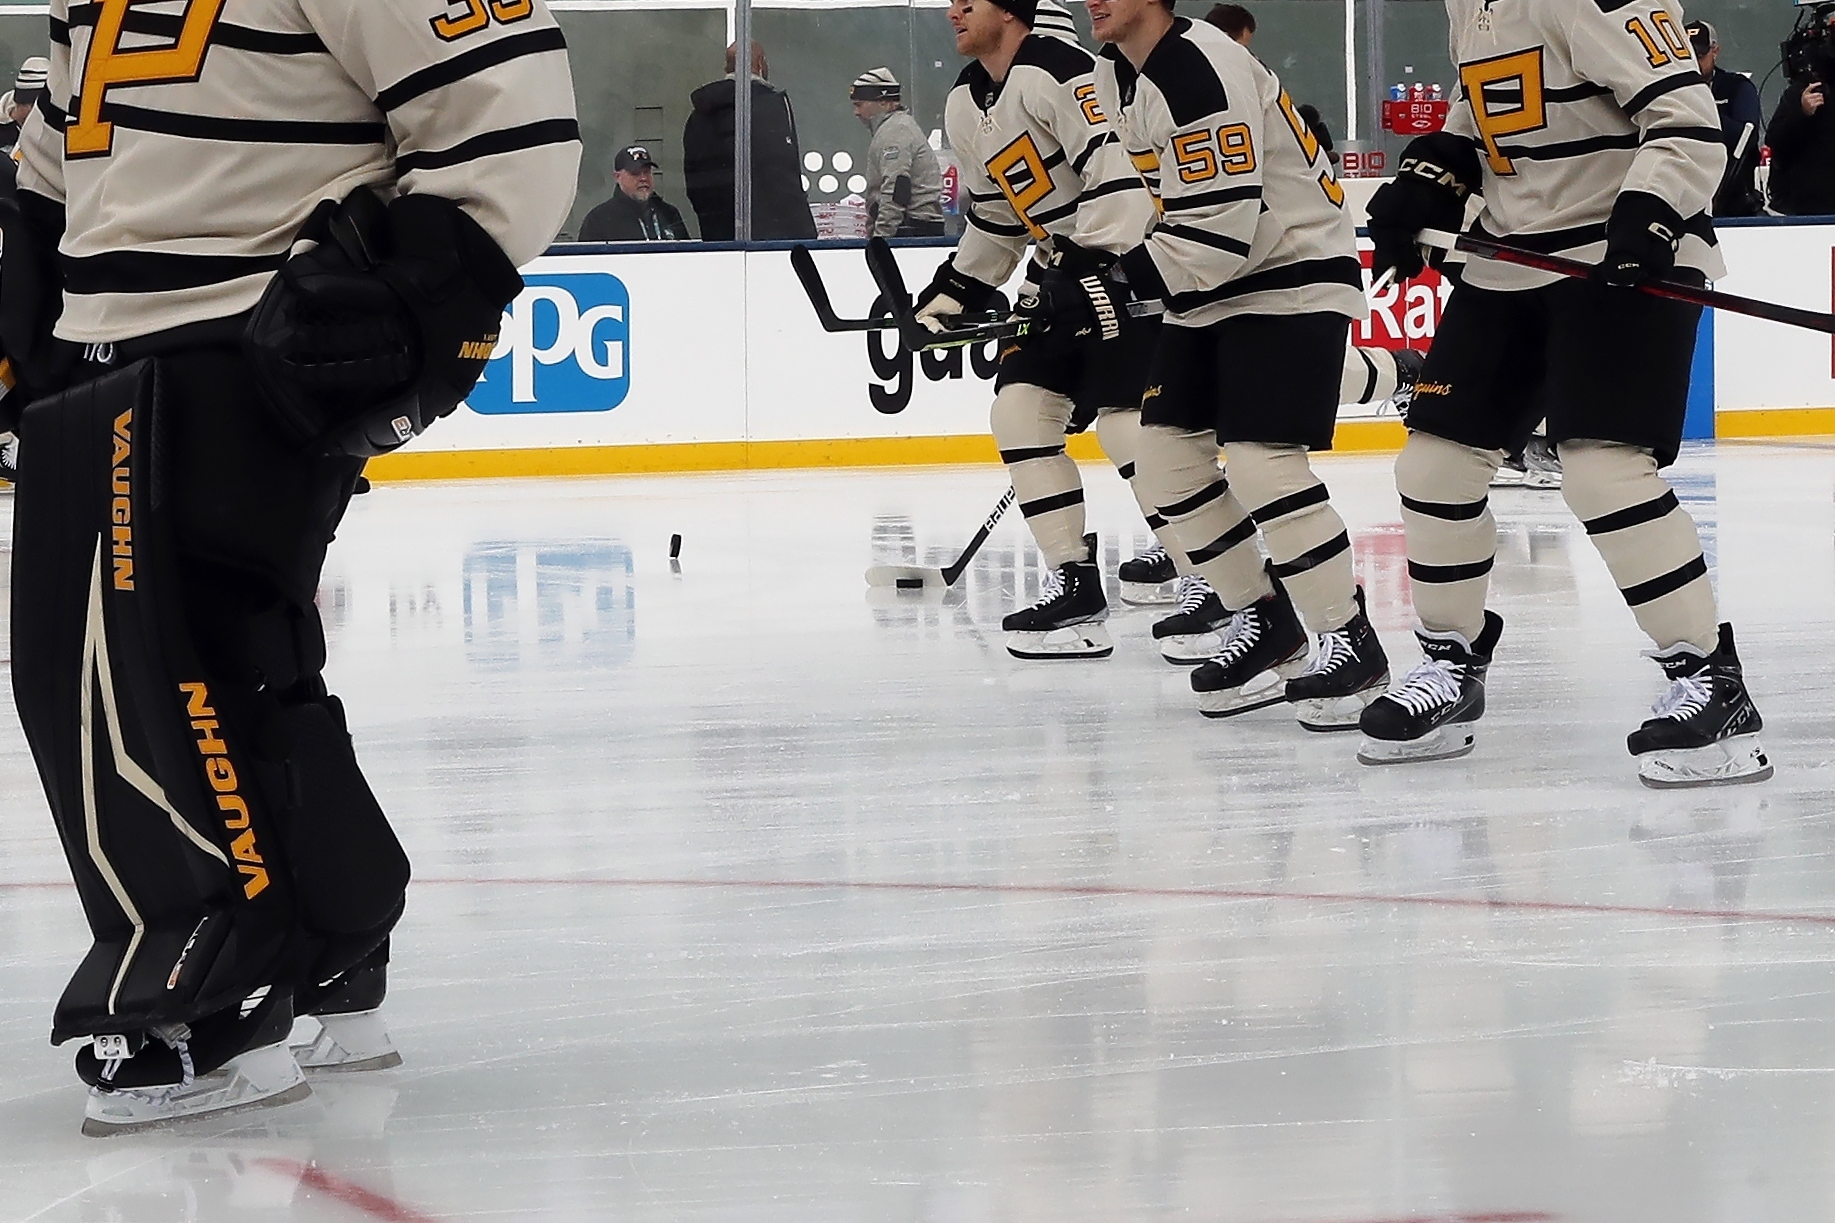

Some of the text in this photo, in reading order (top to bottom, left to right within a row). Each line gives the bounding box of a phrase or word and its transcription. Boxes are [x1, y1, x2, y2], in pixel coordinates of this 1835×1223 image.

[1625, 10, 1692, 69] 10
[1411, 104, 1432, 113] BIO
[1459, 46, 1548, 176] P
[1171, 123, 1257, 184] 59
[1343, 152, 1386, 171] BIO
[1398, 158, 1466, 197] CCM
[1359, 277, 1455, 339] Rat
[112, 408, 136, 592] VAUGHN
[178, 682, 274, 901] VAUGHN
